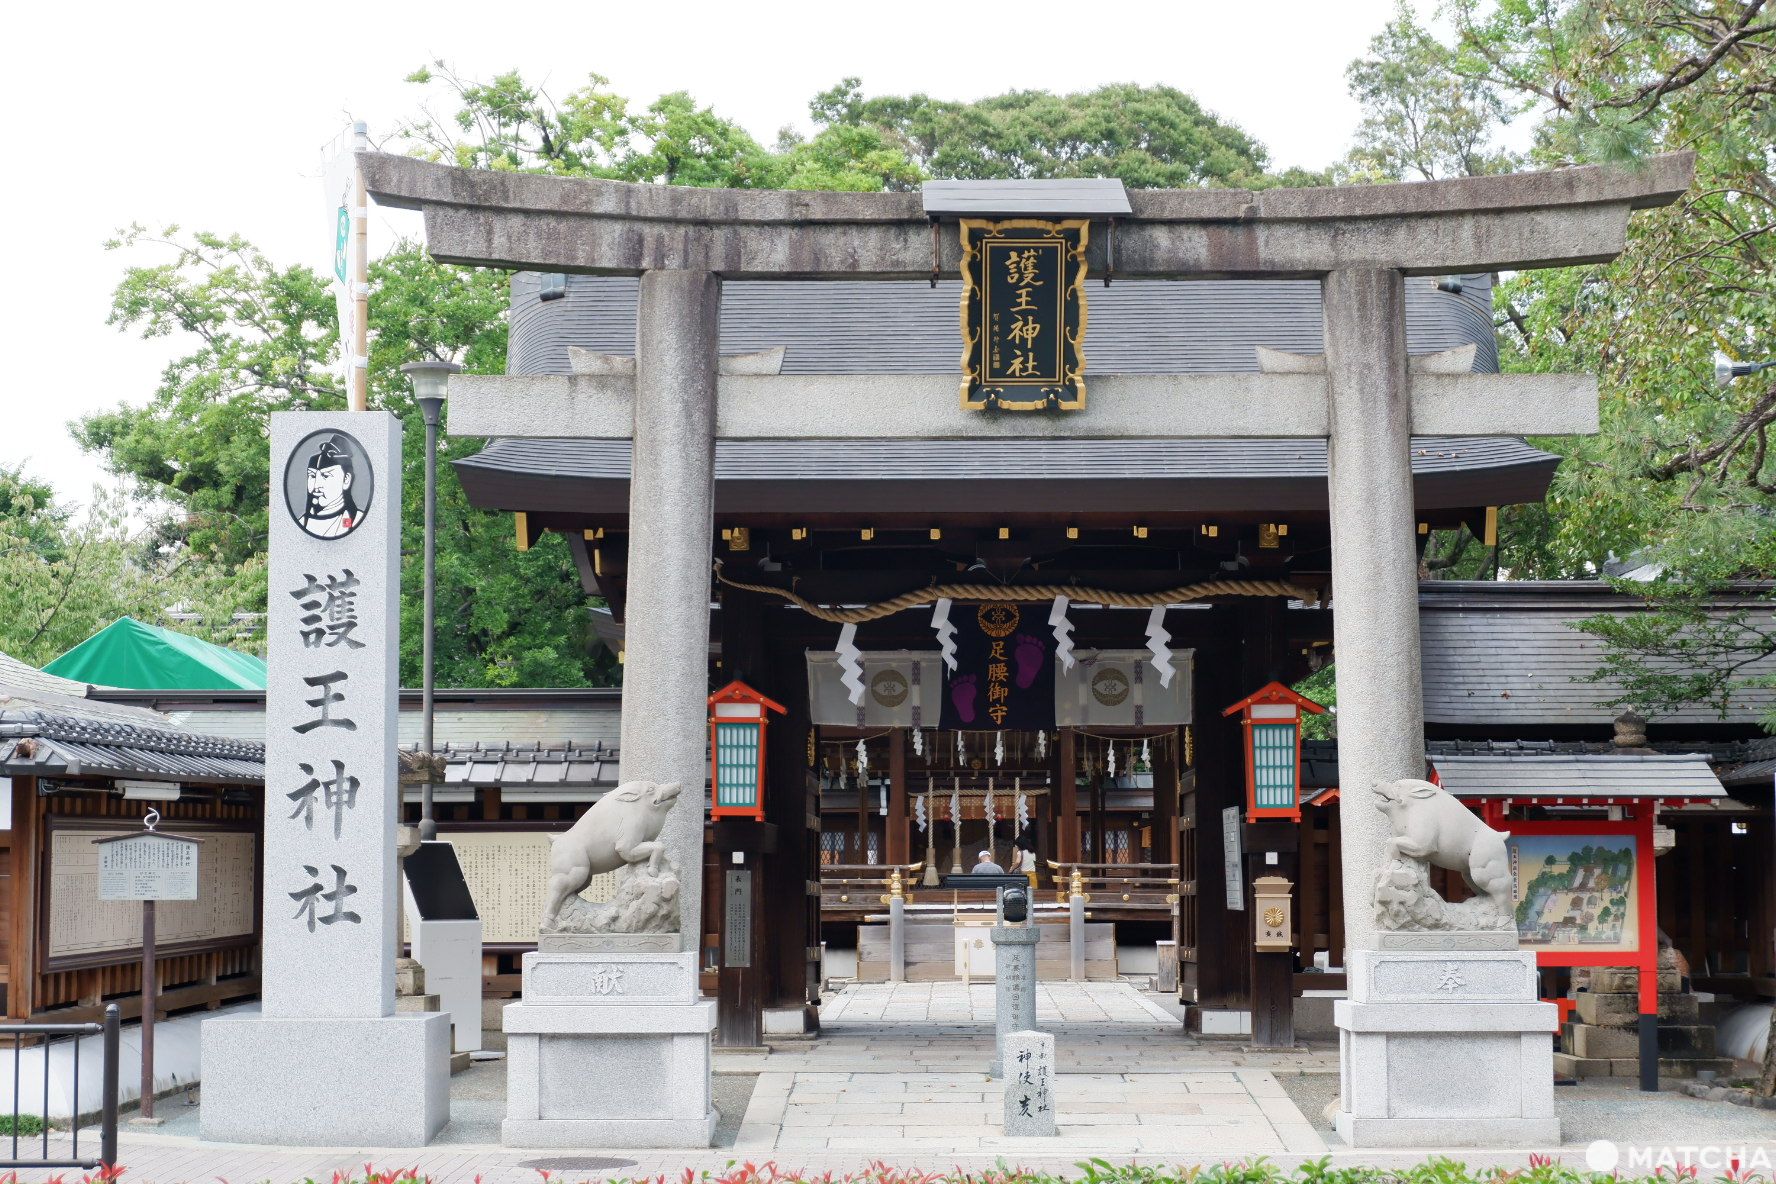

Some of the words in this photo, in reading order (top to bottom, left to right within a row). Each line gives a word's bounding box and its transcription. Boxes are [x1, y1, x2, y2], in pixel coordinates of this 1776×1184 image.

[1004, 249, 1043, 377] 護王神社
[987, 641, 1009, 725] 足腰御守
[286, 567, 366, 934] 護王神社
